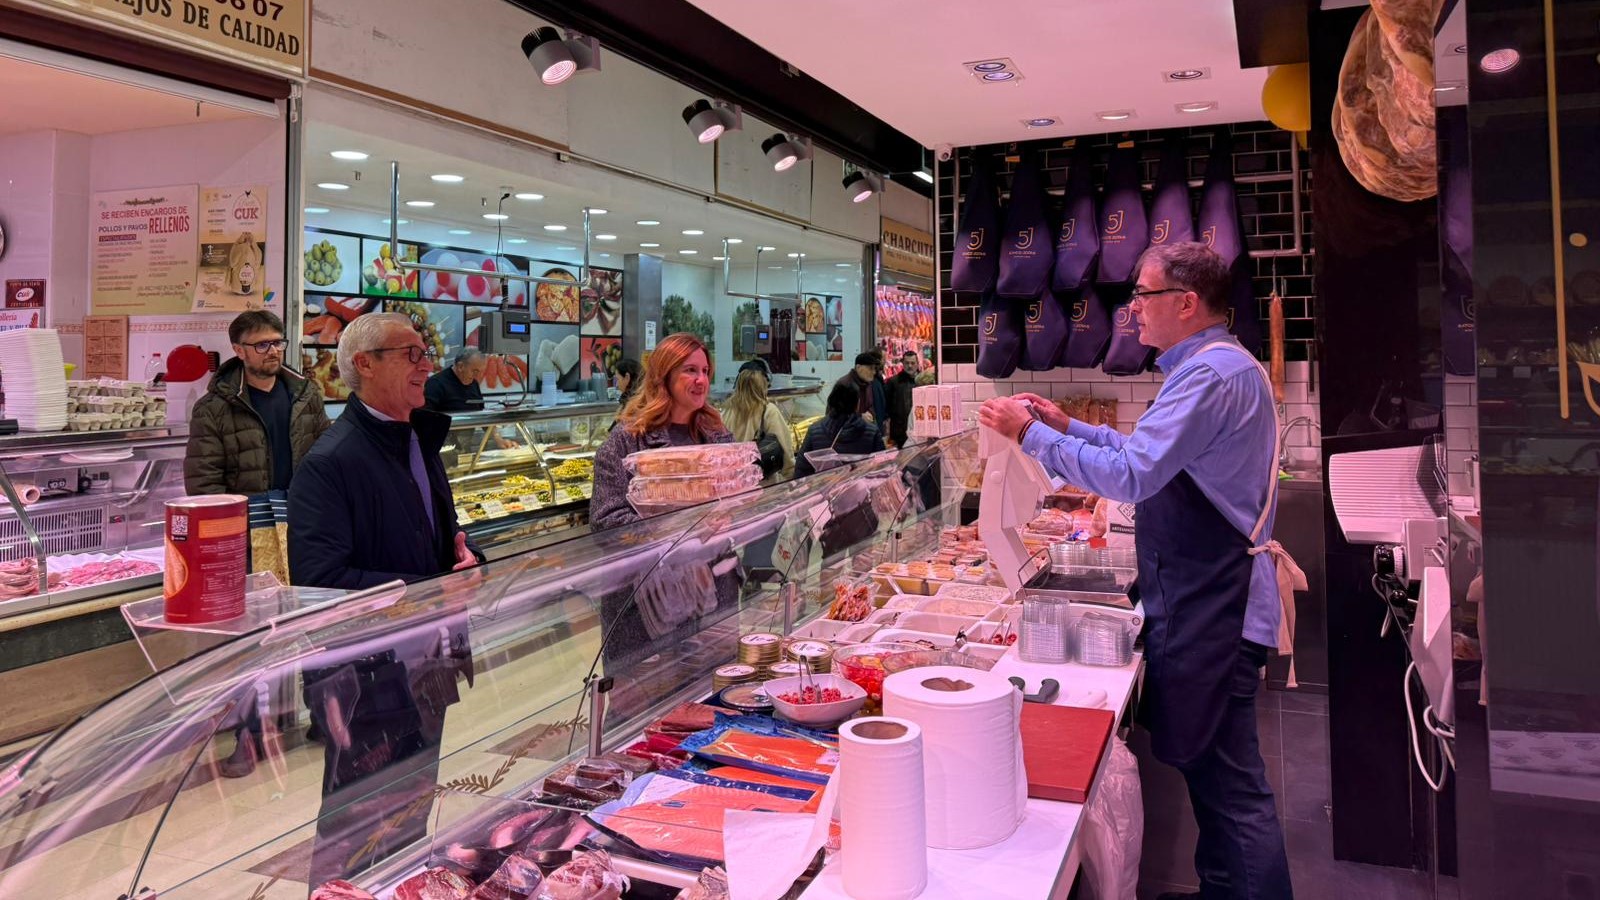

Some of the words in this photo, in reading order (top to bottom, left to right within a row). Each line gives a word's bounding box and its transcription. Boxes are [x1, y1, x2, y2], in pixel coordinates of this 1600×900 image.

[252, 0, 284, 21] 07
[183, 1, 210, 30] DE
[219, 14, 300, 56] CALIDAD
[101, 211, 110, 219] SE
[111, 209, 140, 218] RECIBEN
[140, 207, 177, 217] ENCARGOS
[178, 206, 188, 214] DE
[234, 207, 259, 220] CUK
[1105, 210, 1125, 234] 5J
[148, 215, 190, 234] RELLENOS
[1060, 218, 1076, 242] 5J
[1151, 219, 1170, 244] 5J
[967, 228, 984, 251] 5J
[1015, 227, 1034, 249] 5J
[1026, 300, 1043, 323] 5J
[1070, 299, 1088, 322] 5J
[983, 313, 998, 335] 5J
